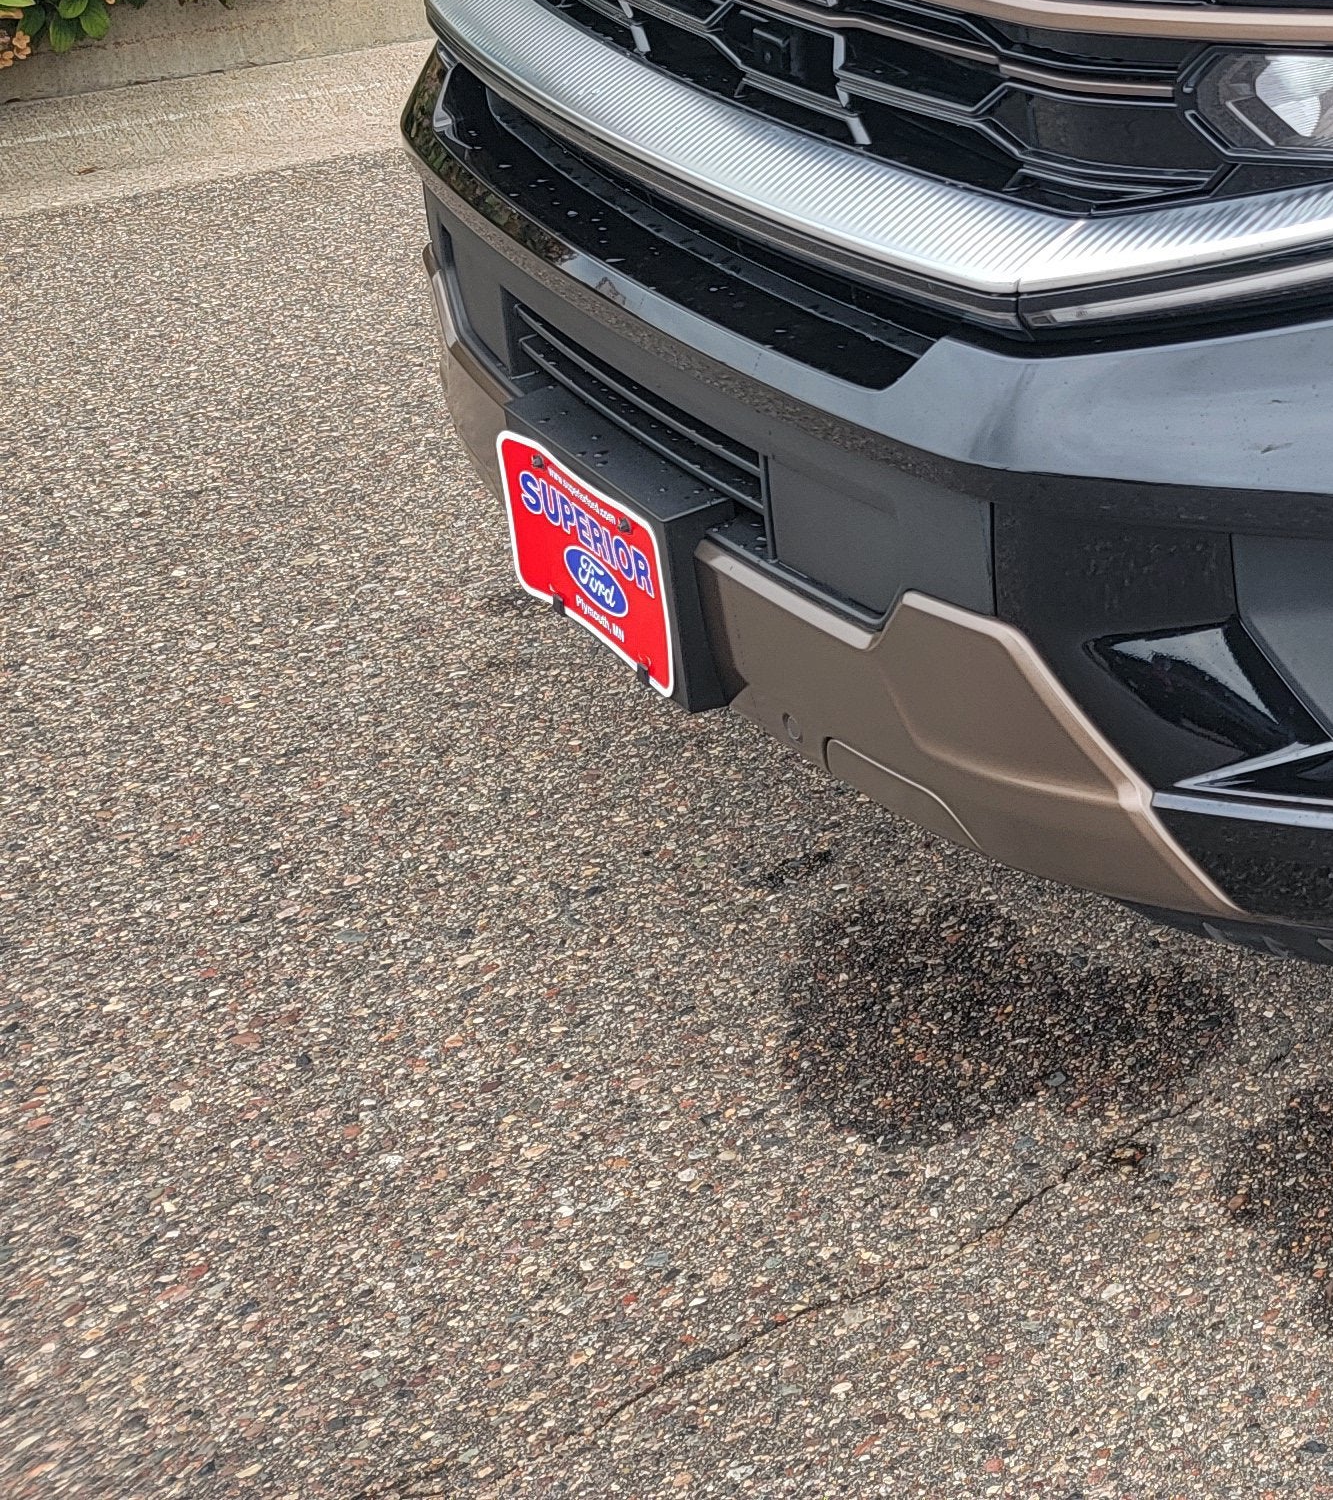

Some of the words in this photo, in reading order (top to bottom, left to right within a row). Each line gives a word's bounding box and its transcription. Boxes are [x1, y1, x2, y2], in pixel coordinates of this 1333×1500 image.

[519, 471, 655, 599] SUPERIOR
[578, 555, 616, 608] Ford
[612, 622, 625, 643] MN
